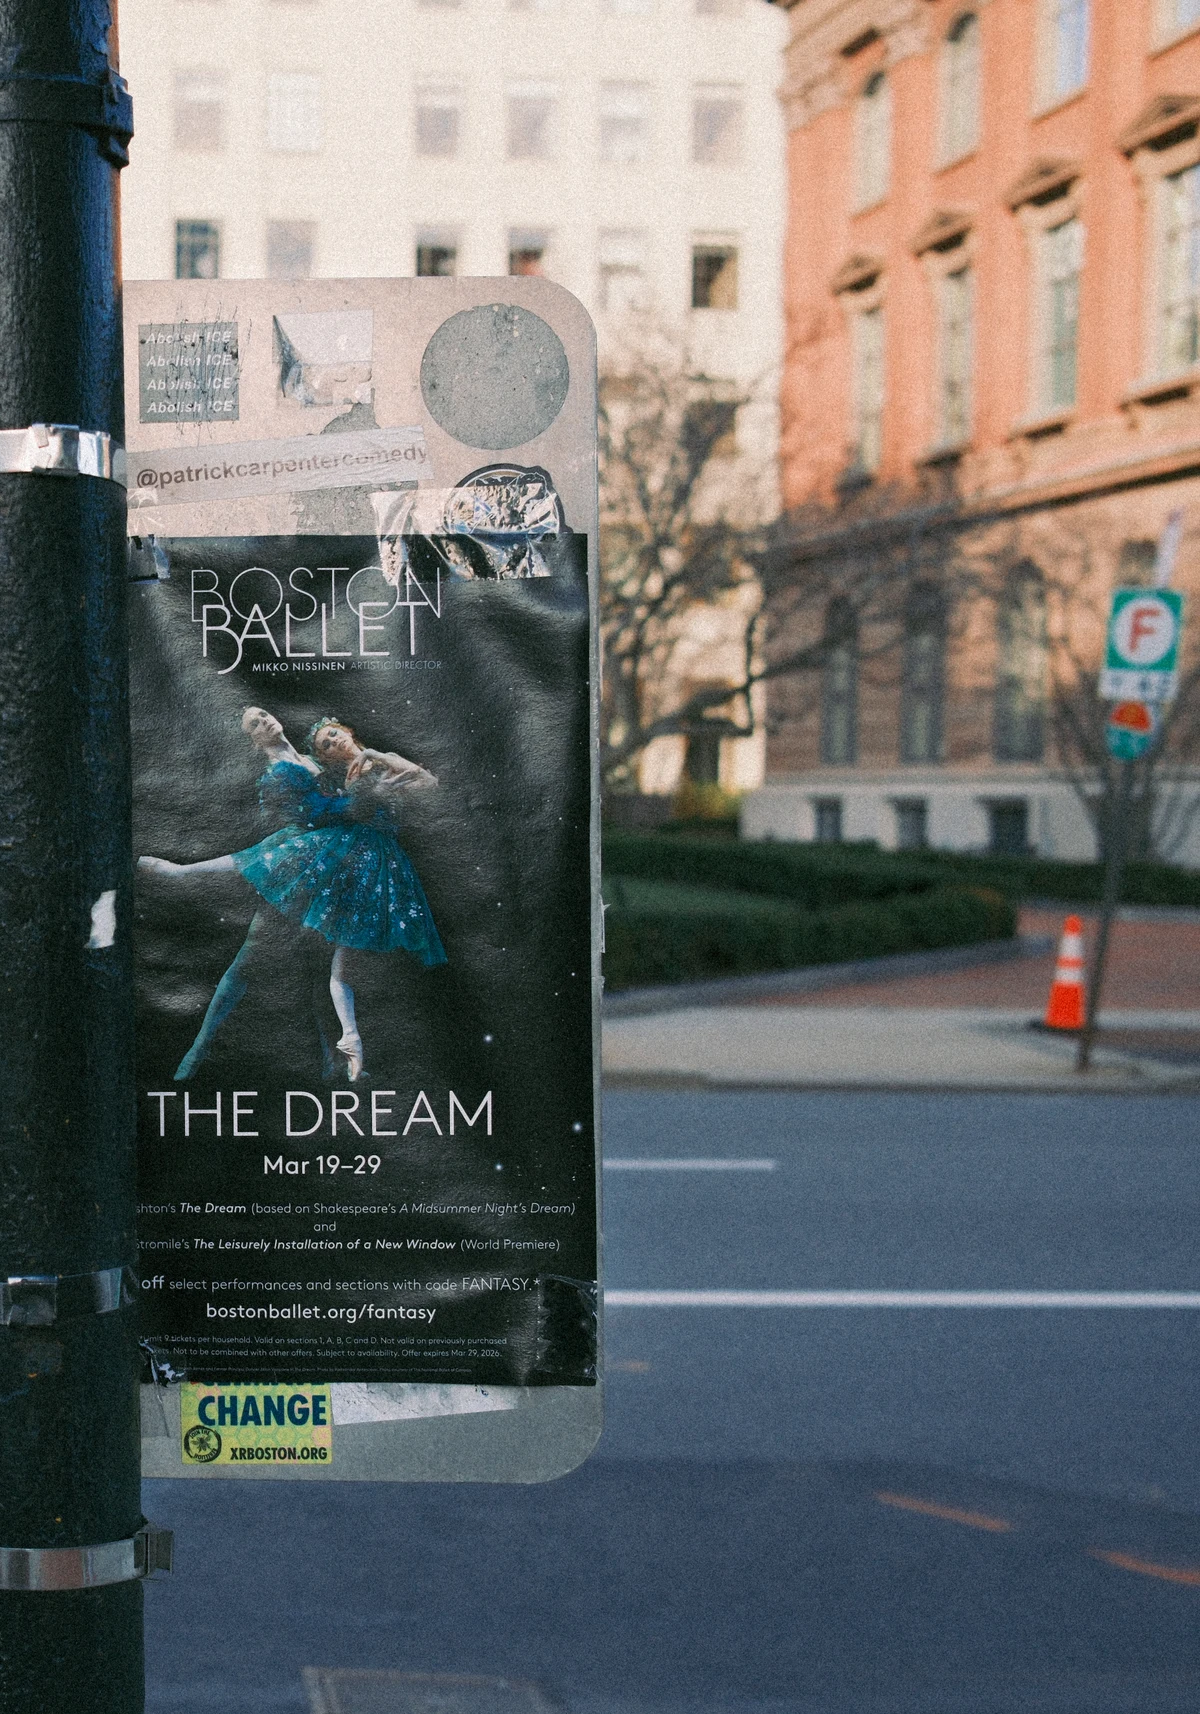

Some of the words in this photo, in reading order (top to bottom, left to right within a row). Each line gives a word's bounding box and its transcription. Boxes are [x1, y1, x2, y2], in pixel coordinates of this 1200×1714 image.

[146, 332, 200, 344] Abosh
[207, 331, 231, 342] ICE
[206, 354, 233, 366] ICE
[208, 377, 232, 389] ICE
[147, 400, 202, 413] Abolish
[137, 446, 426, 489] @patrickcarpentercomedy
[191, 566, 440, 622] BOSTON
[203, 602, 428, 674] BALLET
[1128, 608, 1161, 654] F
[252, 661, 289, 672] MIKKO
[293, 661, 345, 671] NISSINEN
[350, 660, 393, 670] ARTISTIC
[395, 660, 442, 670] DIRECTOR
[147, 1091, 259, 1136] THE
[285, 1090, 492, 1136] DREAM
[263, 1155, 309, 1175] Mar
[136, 1203, 176, 1213] shton's
[180, 1202, 201, 1213] The
[205, 1203, 246, 1213] Dream
[251, 1203, 292, 1215] (based
[295, 1206, 310, 1214] on
[313, 1203, 396, 1217] Shakespeare's
[399, 1204, 408, 1214] A
[411, 1203, 482, 1214] Midsummer
[485, 1203, 527, 1216] Night's
[530, 1203, 576, 1215] Dream)
[313, 1221, 337, 1232] and
[194, 1239, 214, 1249] The
[218, 1239, 271, 1252] Leisurely
[274, 1239, 343, 1250] Installation
[346, 1239, 361, 1250] of
[363, 1242, 371, 1250] a
[375, 1239, 402, 1250] New
[406, 1239, 457, 1250] Window
[460, 1239, 500, 1251] (World
[504, 1239, 560, 1251] Premiere)
[141, 1275, 165, 1289] off
[169, 1278, 207, 1290] select
[211, 1278, 302, 1292] performances
[306, 1279, 332, 1290] and
[336, 1279, 389, 1291] sections
[393, 1279, 422, 1291] with
[425, 1279, 457, 1291] code
[206, 1303, 436, 1323] bostonballet.org/fantasy
[212, 1335, 252, 1343] household.
[255, 1336, 273, 1344] Valid
[287, 1336, 317, 1344] sections
[397, 1337, 414, 1345] valid
[428, 1337, 465, 1346] previously
[467, 1337, 507, 1345] purchased
[211, 1348, 249, 1356] combined
[291, 1349, 314, 1357] offers.
[316, 1349, 345, 1358] Subject
[357, 1349, 400, 1358] availability.
[401, 1349, 420, 1357] Offer
[423, 1350, 449, 1358] expires
[468, 1349, 479, 1357] 29,
[198, 1394, 327, 1426] CHANGE
[230, 1447, 327, 1460] XRBOSTON.ORG
